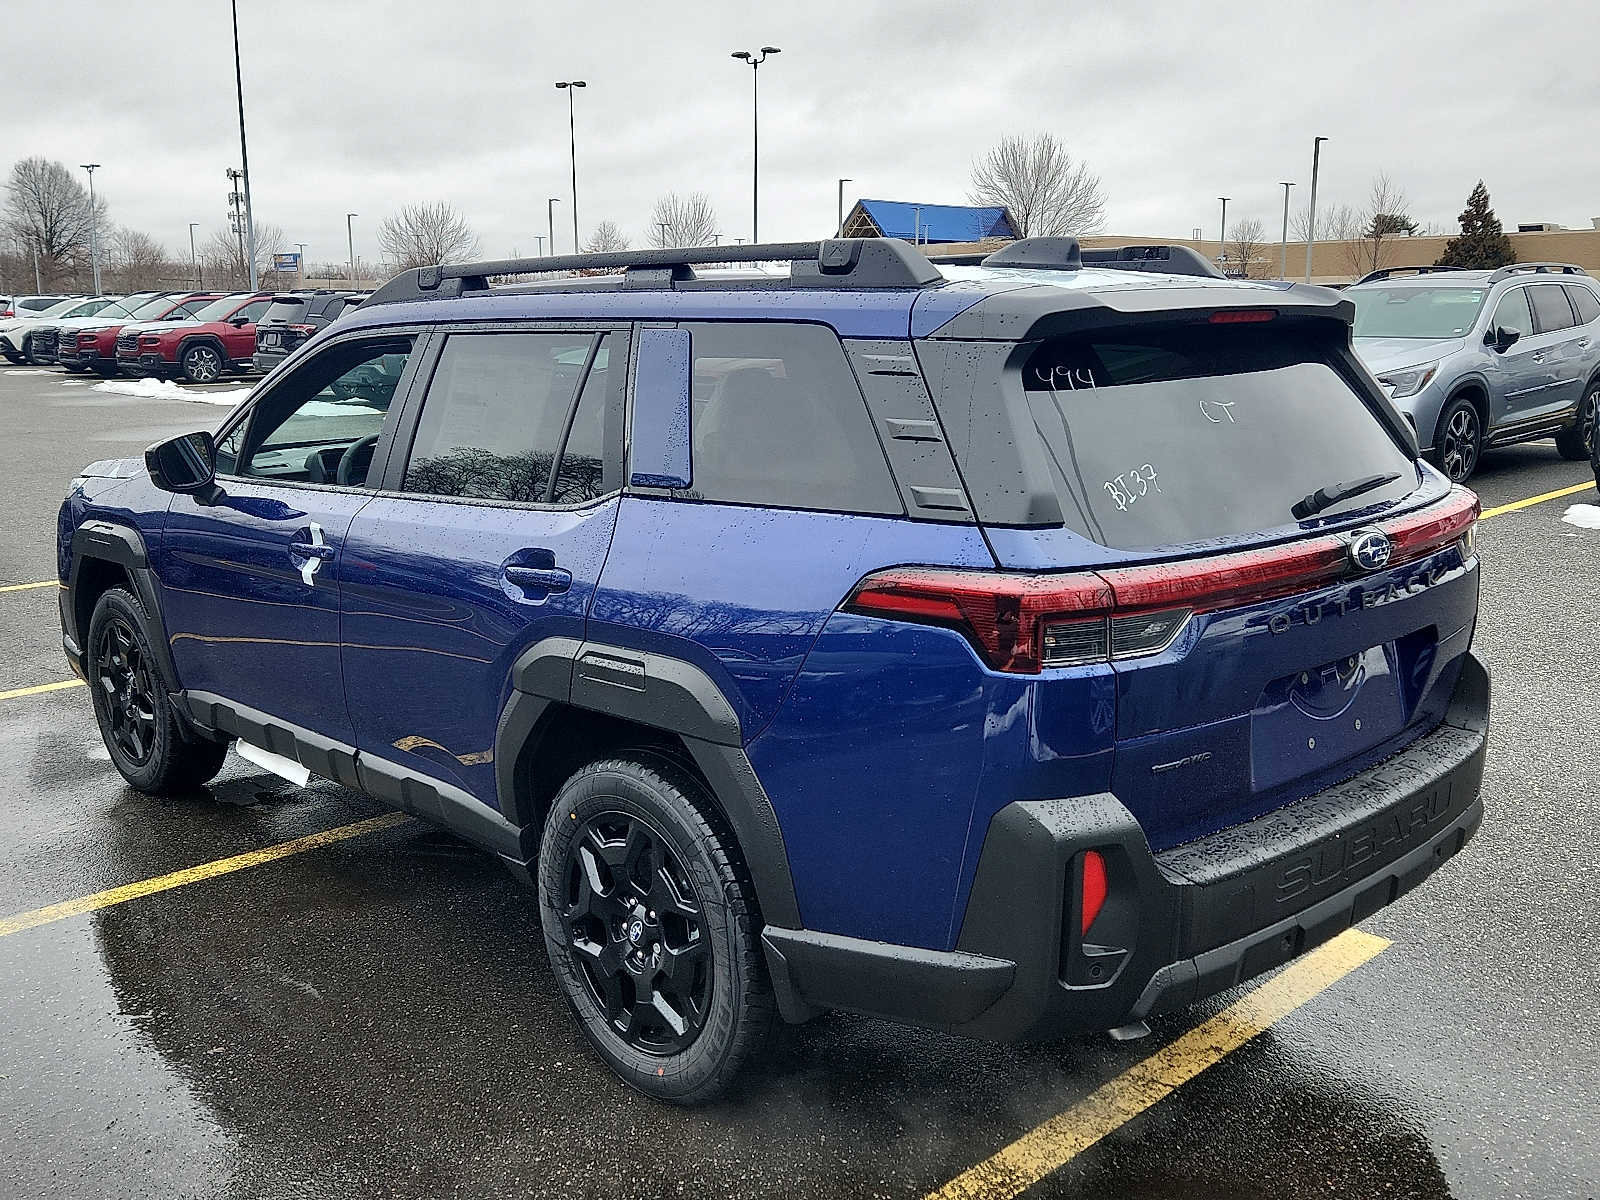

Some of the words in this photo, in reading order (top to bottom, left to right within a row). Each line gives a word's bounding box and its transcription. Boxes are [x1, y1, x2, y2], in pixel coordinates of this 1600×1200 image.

[1035, 365, 1097, 392] 494
[1199, 400, 1235, 423] CT
[1269, 566, 1447, 635] OUTBACK
[1277, 781, 1462, 903] SUBARU
